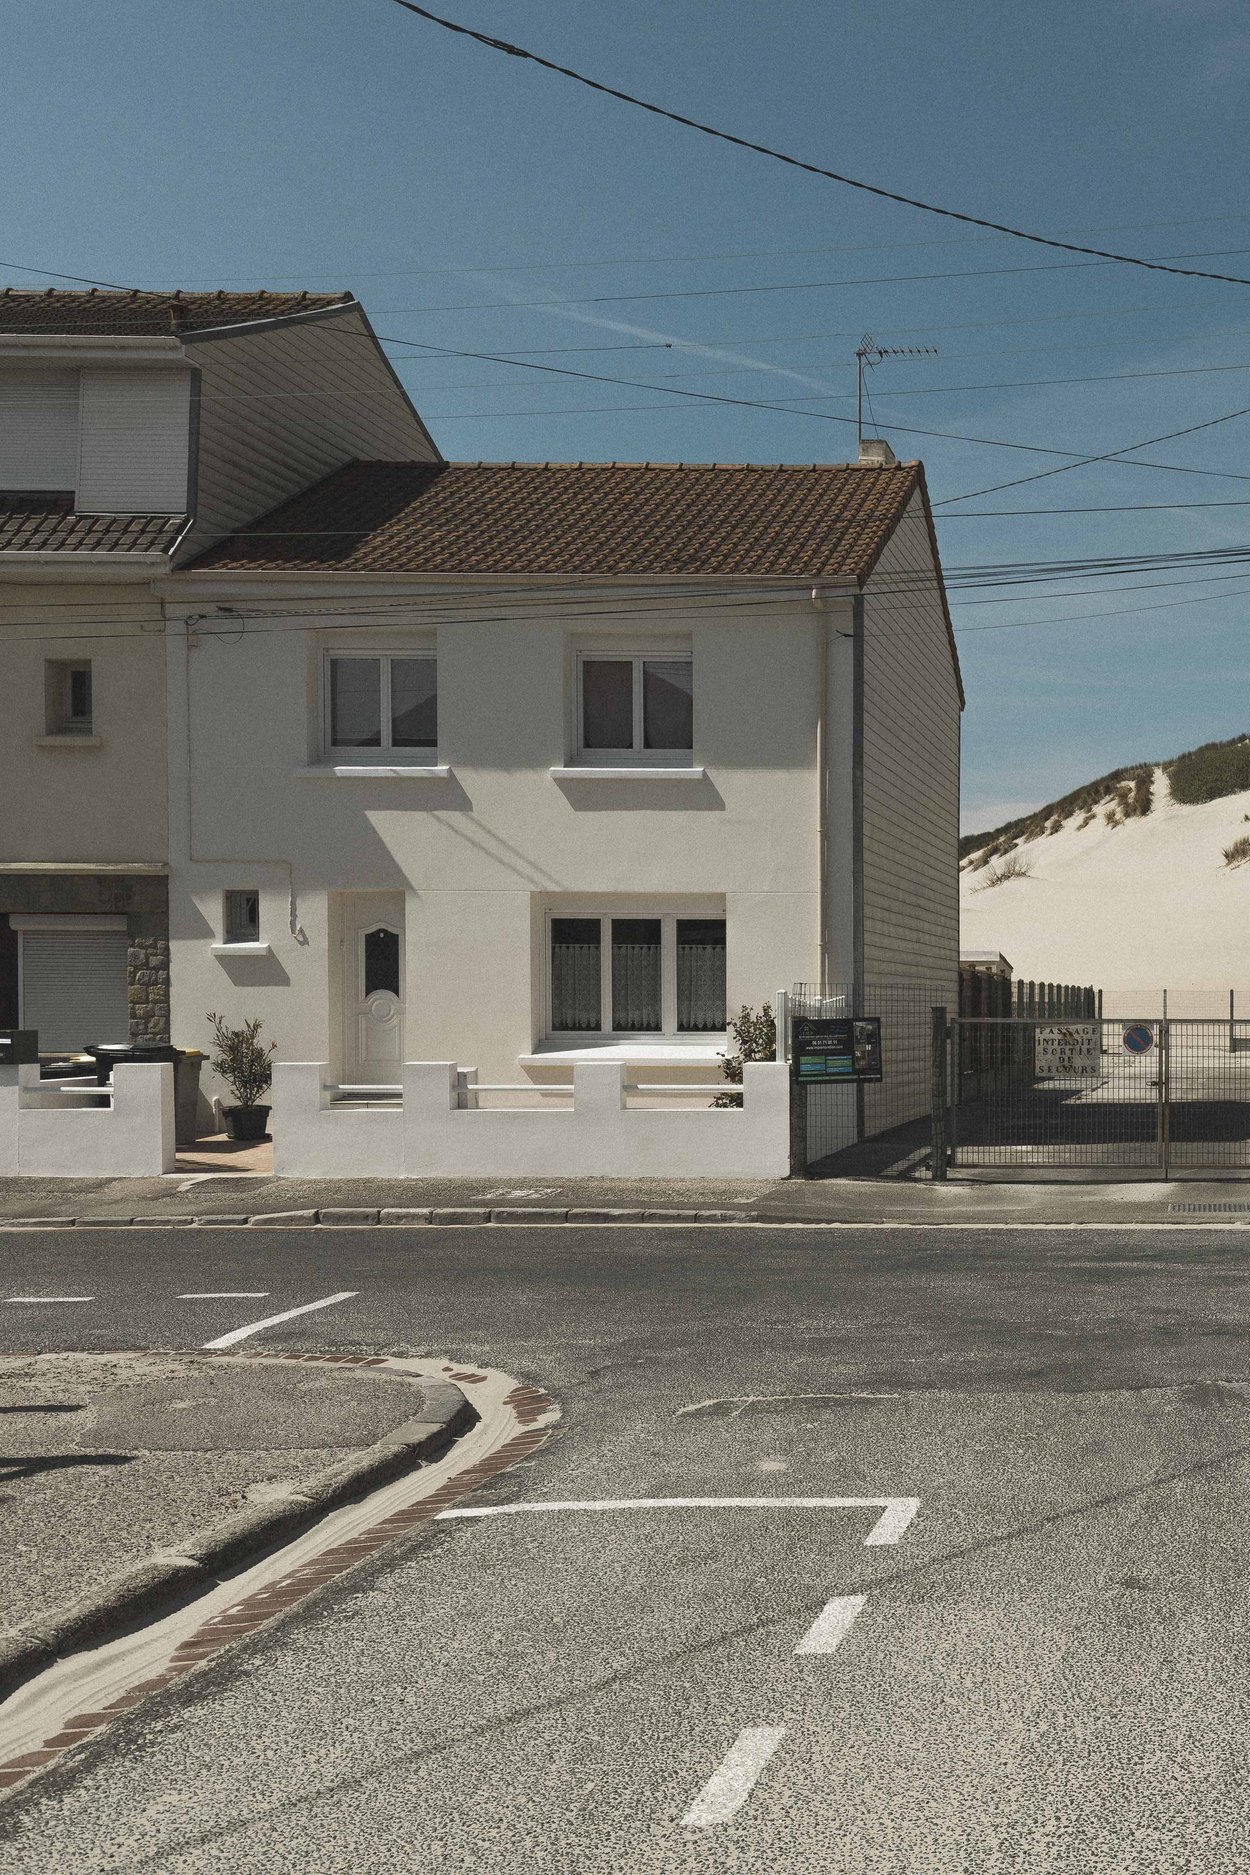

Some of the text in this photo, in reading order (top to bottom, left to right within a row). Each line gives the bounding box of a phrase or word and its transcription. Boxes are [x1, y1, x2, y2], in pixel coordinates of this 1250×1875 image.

[1039, 1027, 1098, 1035] PASSAGE
[1058, 1056, 1074, 1064] DE
[1038, 1065, 1097, 1074] SECOURS
